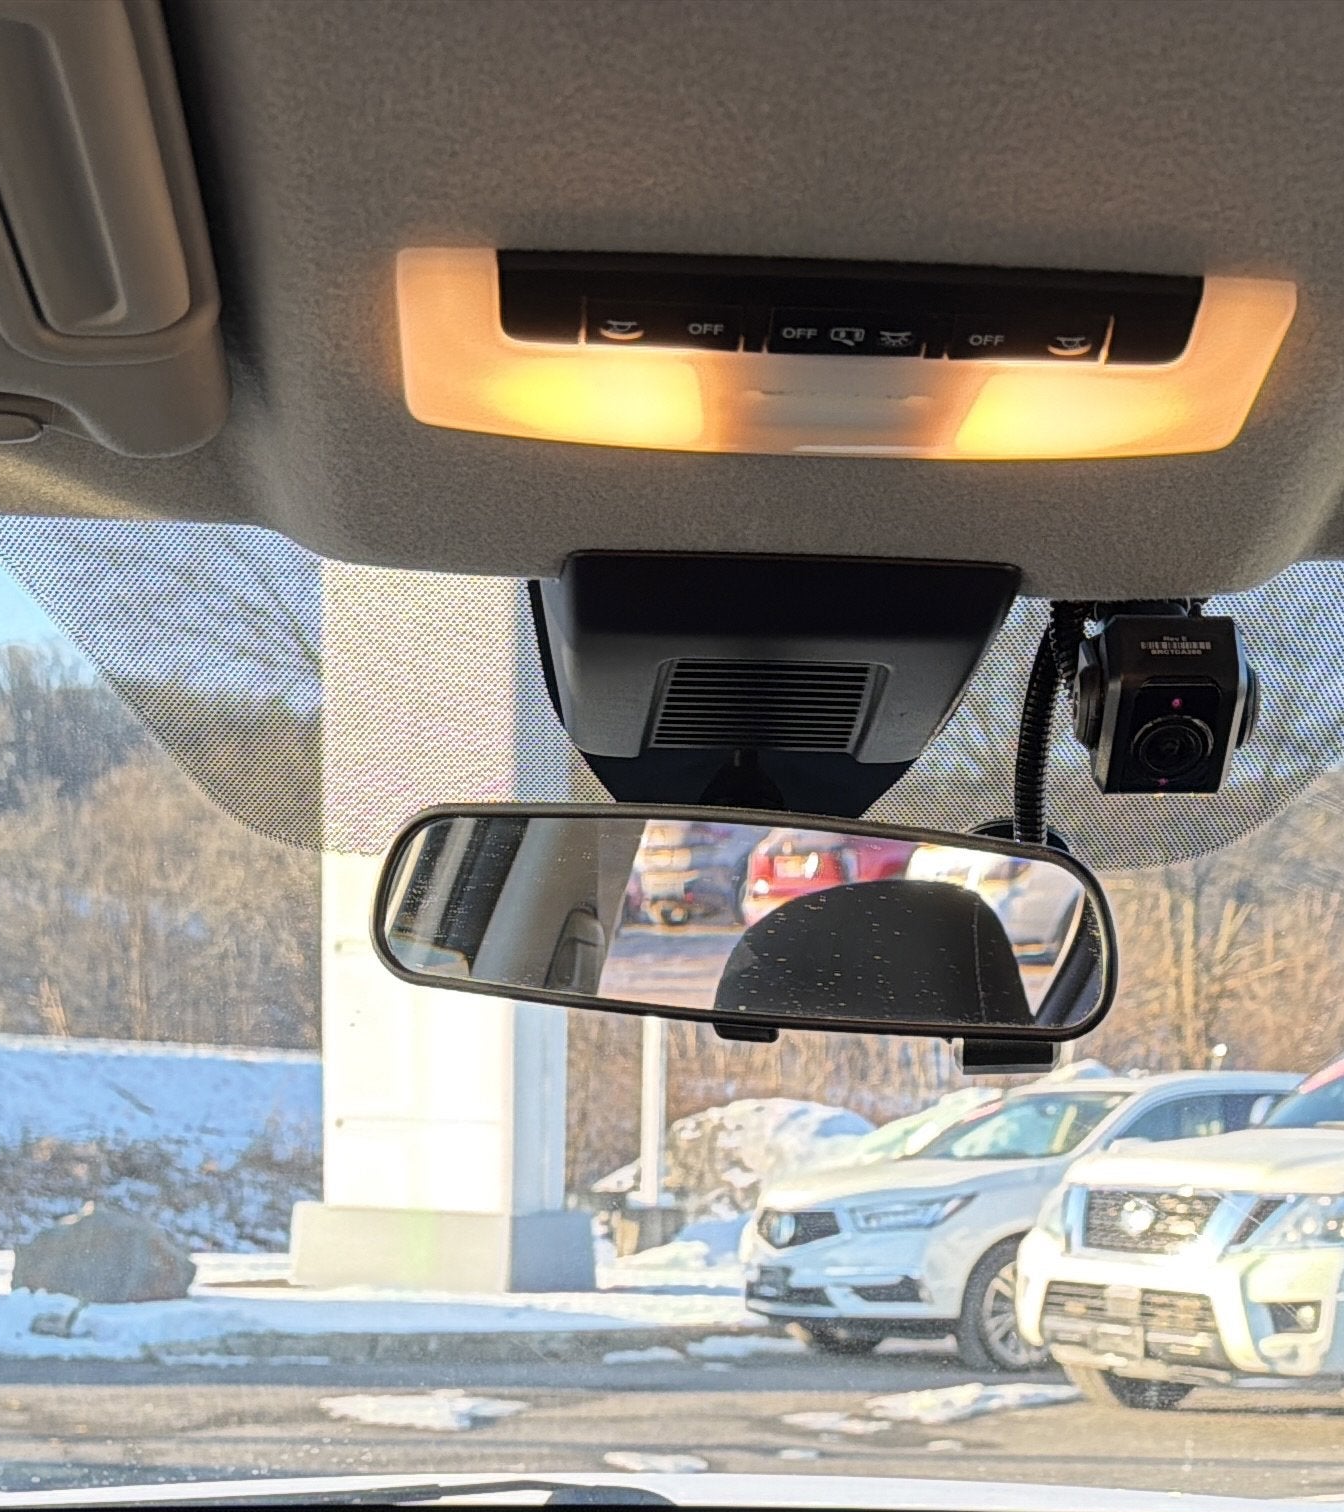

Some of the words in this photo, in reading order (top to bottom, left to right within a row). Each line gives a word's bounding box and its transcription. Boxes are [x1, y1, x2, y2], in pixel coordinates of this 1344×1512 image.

[687, 321, 725, 338] OFF
[781, 325, 818, 341] OFF
[968, 332, 1005, 348] OFF
